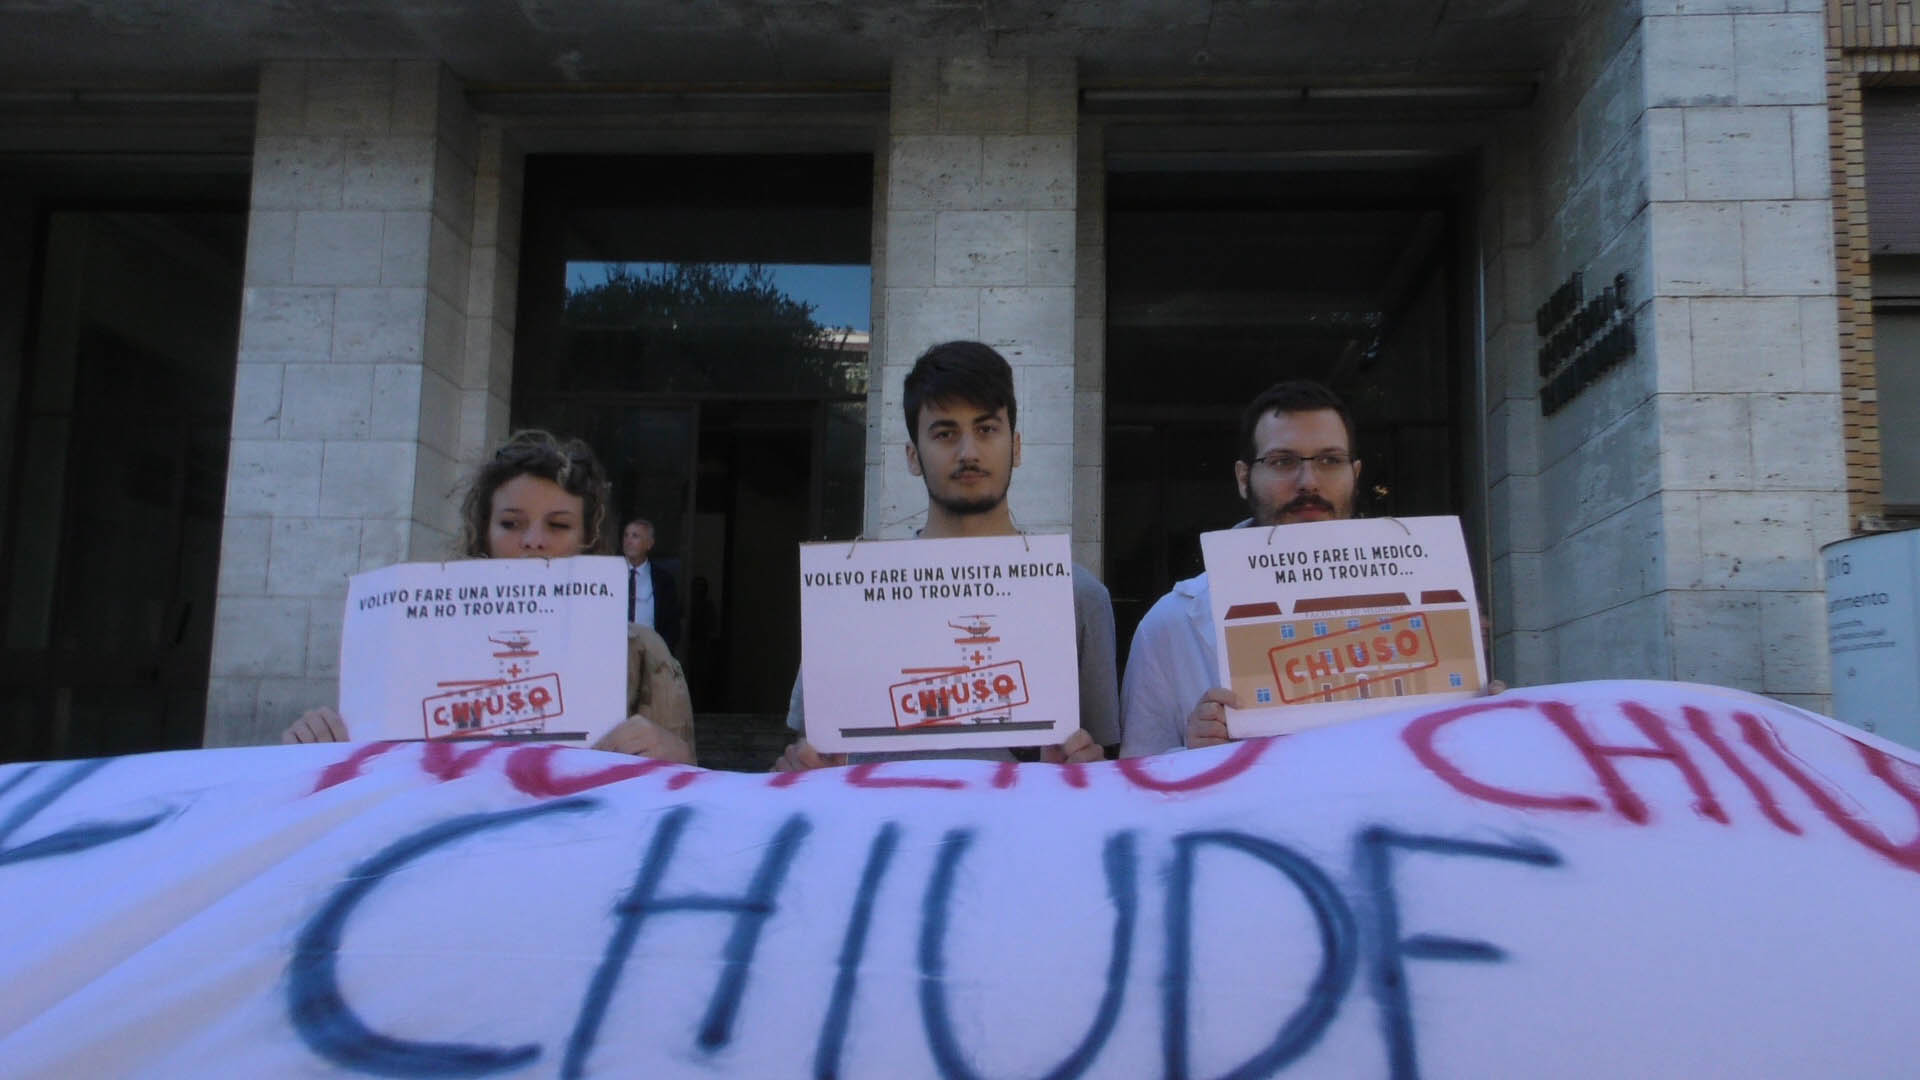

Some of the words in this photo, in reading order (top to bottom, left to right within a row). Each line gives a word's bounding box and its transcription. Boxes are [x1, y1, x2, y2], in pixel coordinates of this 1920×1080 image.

[1248, 551, 1308, 569] VOLEVO
[1313, 548, 1350, 563] FARE
[1354, 547, 1367, 560] IL
[805, 571, 864, 587] VOLEVO
[871, 569, 907, 584] FARE
[914, 568, 944, 582] UNA
[951, 565, 1002, 580] VISITA
[1275, 569, 1297, 584] MA
[1302, 567, 1323, 581] HO
[359, 589, 409, 610] VOLEVO
[415, 588, 453, 601] FARE
[458, 586, 489, 600] UNA
[496, 584, 546, 598] VISITA
[864, 587, 885, 602] MA
[892, 586, 913, 600] HO
[406, 604, 428, 619] MA
[434, 604, 456, 617] HO
[1286, 630, 1418, 684] CHIUSO
[901, 674, 1016, 714] CHIUSO
[434, 687, 551, 726] CHIUSO
